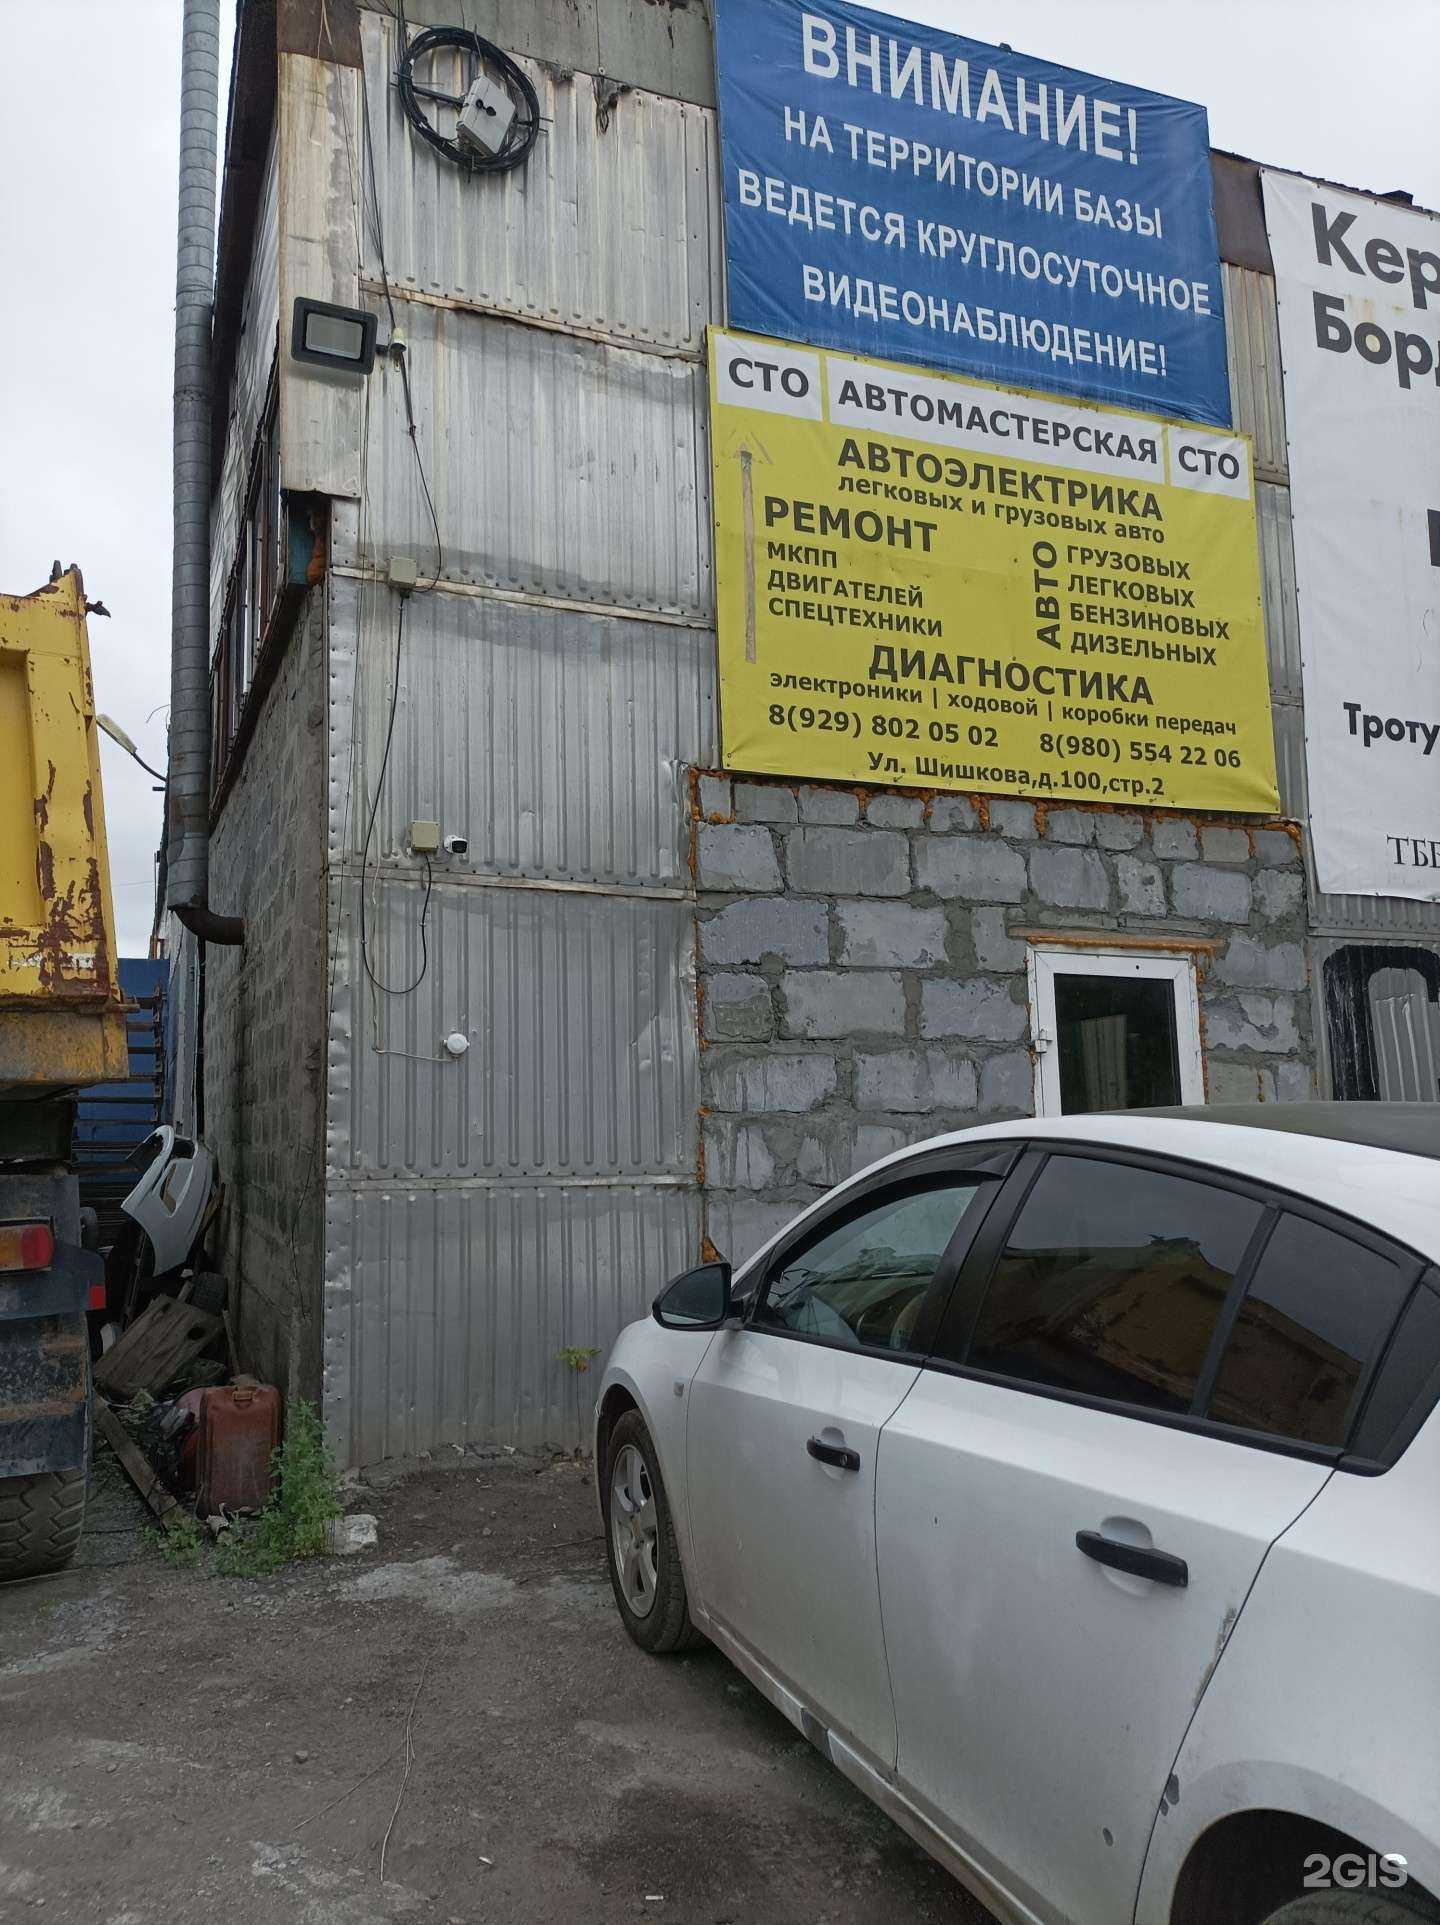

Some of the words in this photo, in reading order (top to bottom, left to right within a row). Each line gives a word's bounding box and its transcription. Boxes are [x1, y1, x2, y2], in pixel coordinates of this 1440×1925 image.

[801, 12, 1138, 165] ВНИМАНИЕ!
[784, 105, 833, 153] НА
[843, 122, 1064, 216] ТЕРРИТОРИИ
[1075, 187, 1162, 239] БАЗЫ
[738, 168, 906, 249] ВЕДЕТСЯ
[917, 219, 1211, 316] КРУГЛОСУТОЧНОЕ
[802, 264, 1168, 377] ВИДЕОНАБЛЮДЕНИЕ!
[1312, 290, 1440, 390] Бор
[728, 357, 810, 398] СТО
[838, 380, 1158, 465] АВТОМАСТЕРСКАЯ
[1178, 444, 1240, 481] СТО
[837, 438, 1164, 522] АВТОЭЛЕКТРИКА
[838, 475, 964, 513] легковых
[971, 501, 985, 515] и
[994, 504, 1107, 536] грузовых
[1114, 523, 1165, 544] авто
[764, 496, 938, 553] РЕМОНТ
[767, 541, 838, 569] МКПП
[1066, 545, 1191, 580] ГРУЗОВЫХ
[767, 569, 923, 609] ДВИГАТЕЛЕЙ
[768, 597, 943, 638] СПЕЦТЕХНИКИ
[1032, 541, 1062, 650] АВТО
[1068, 574, 1196, 608] ЛЕГКОВЫХ
[1070, 602, 1231, 640] БЕНЗИНОВЫХ
[1070, 631, 1217, 666] ДИЗЕЛЬНЫХ
[770, 672, 923, 704] электроники
[947, 693, 1038, 717] ходовой
[1062, 705, 1149, 728] коробки
[1155, 714, 1237, 735] передач
[868, 644, 1154, 706] ДИАГНОСТИКА
[768, 703, 862, 739] 8(929)
[871, 713, 920, 740] 802
[928, 721, 960, 744] 05
[968, 725, 999, 748] 02
[1039, 733, 1121, 763] 8(980)
[1129, 740, 1172, 764] 554
[1180, 745, 1208, 766] 22
[1214, 748, 1242, 769] 06
[867, 751, 906, 774] Ул.
